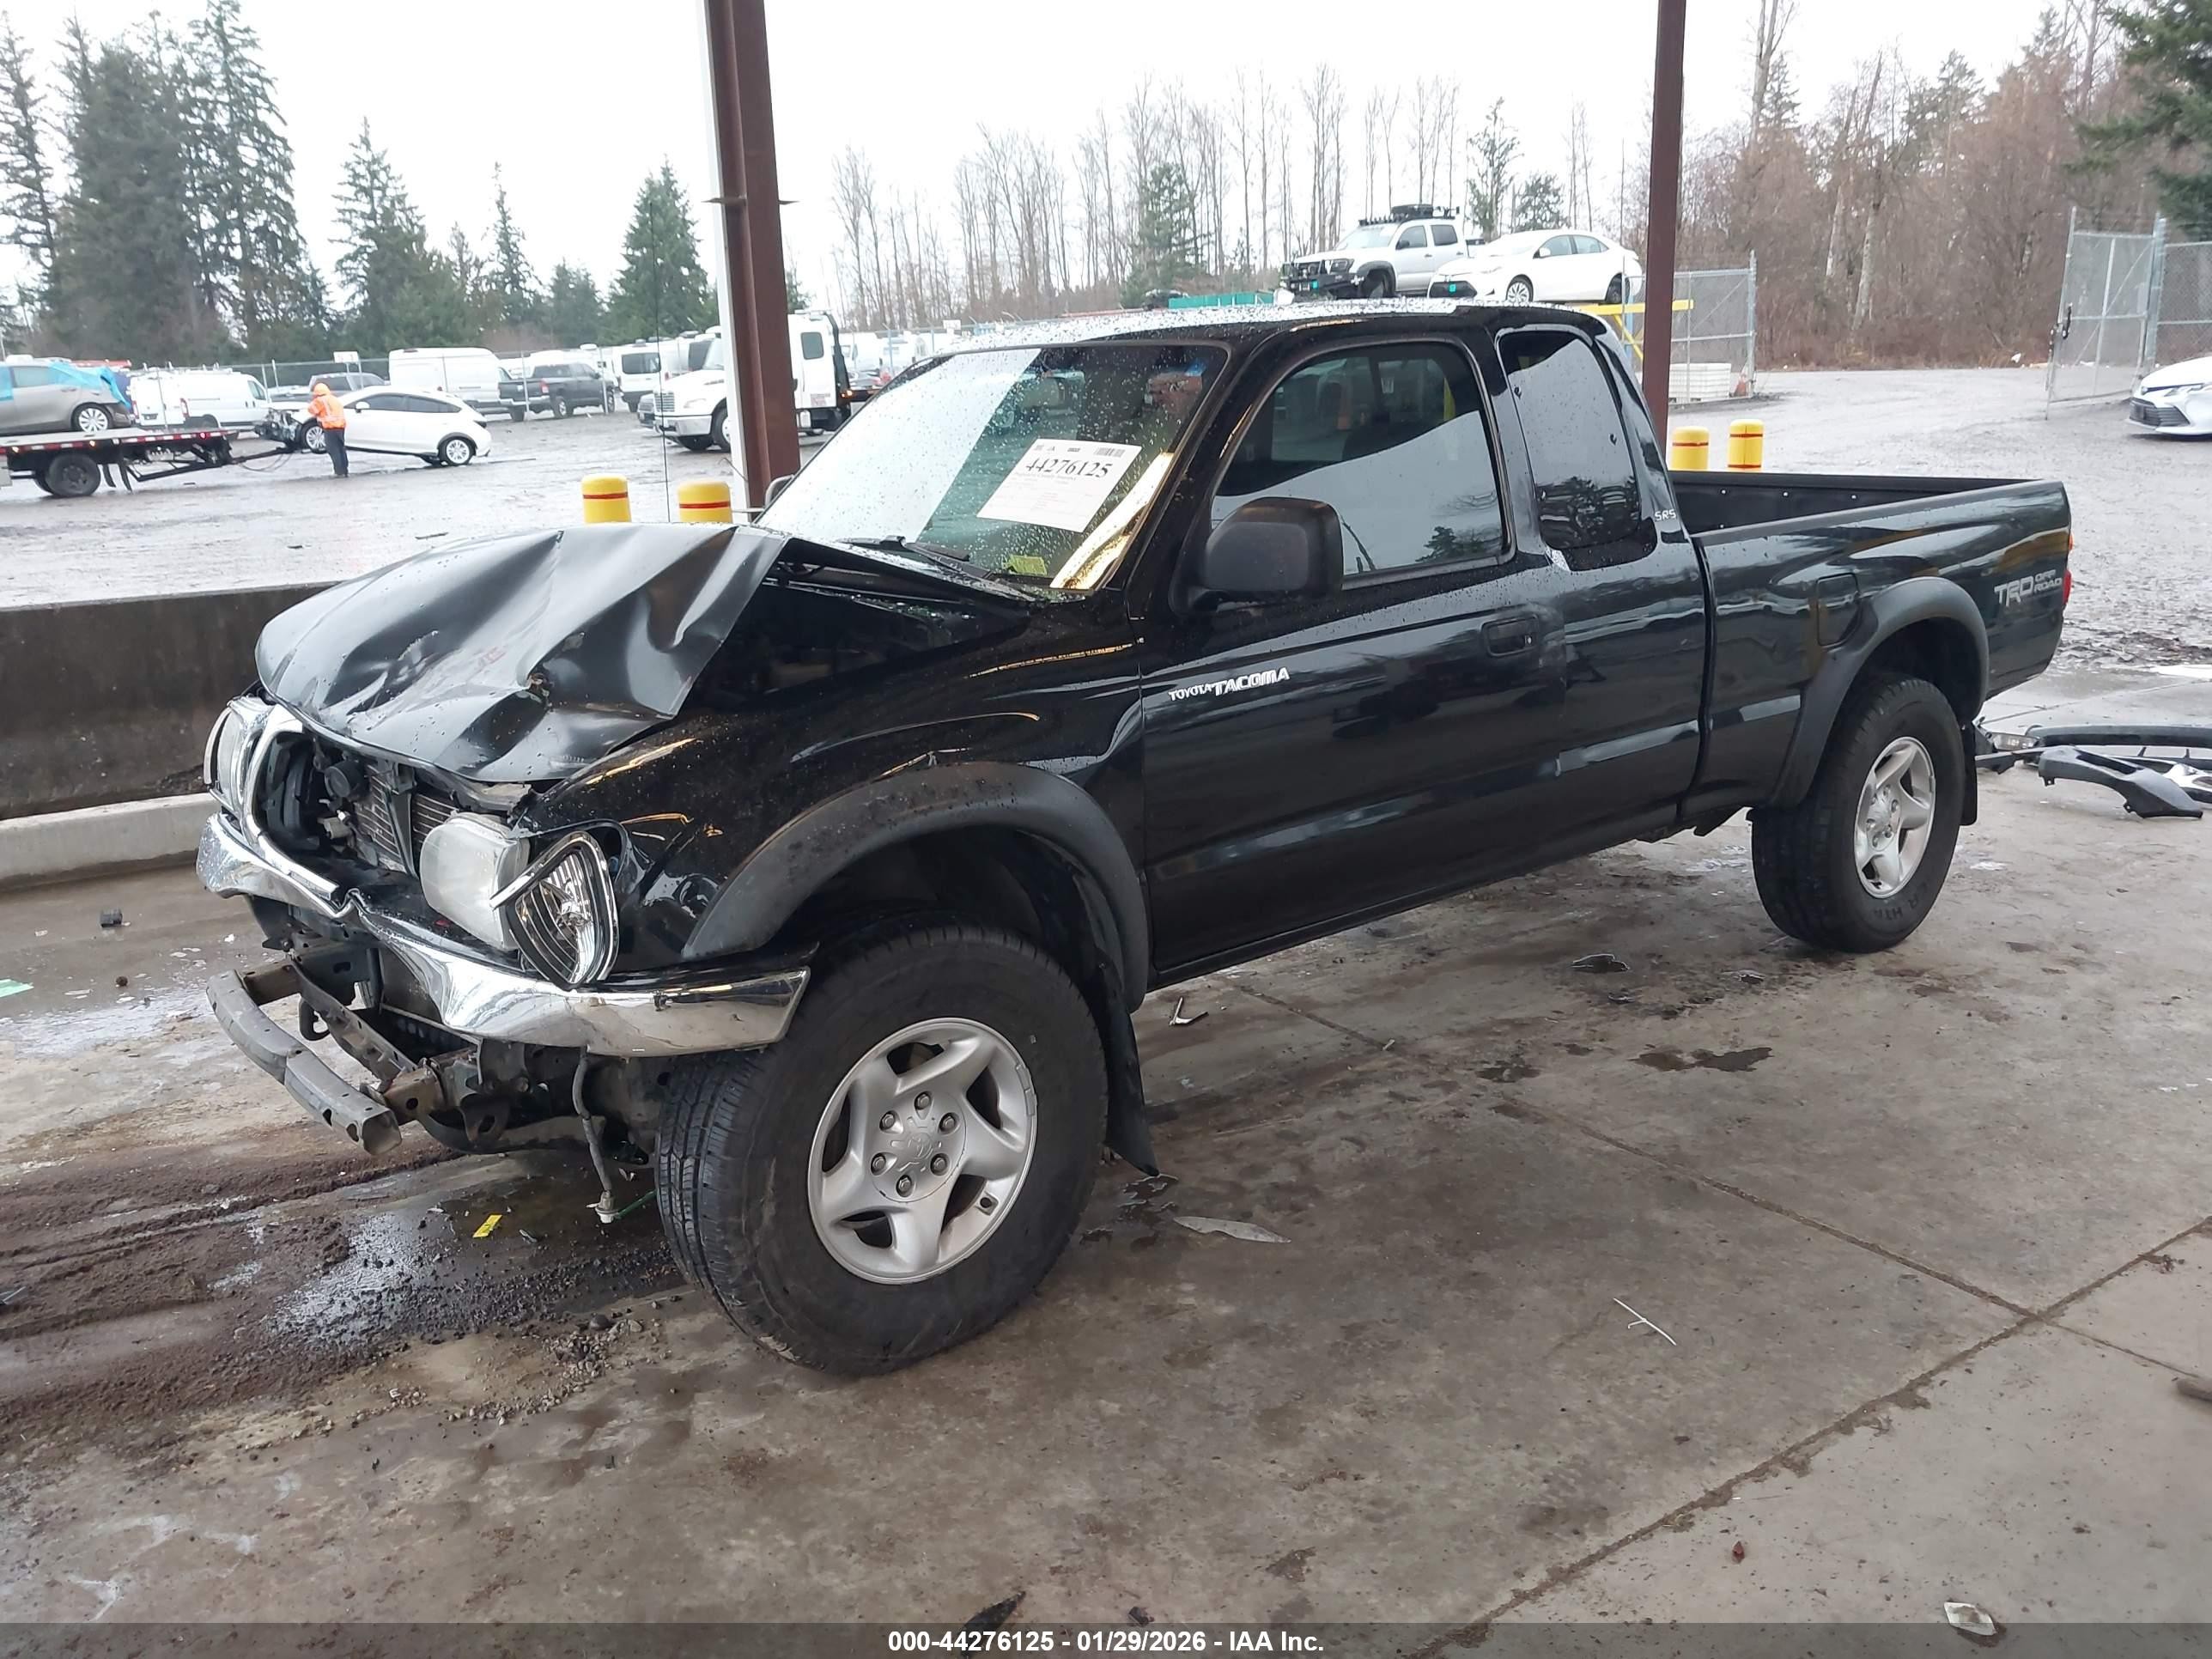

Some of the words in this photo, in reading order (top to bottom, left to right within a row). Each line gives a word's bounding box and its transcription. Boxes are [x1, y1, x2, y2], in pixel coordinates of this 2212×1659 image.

[1025, 458, 1114, 478] 44276125
[2033, 577, 2063, 593] ROAD
[2034, 569, 2057, 582] OFF
[1993, 575, 2034, 607] TRD
[1168, 683, 1212, 702] TOYOTA
[1210, 667, 1291, 696] TACOMA
